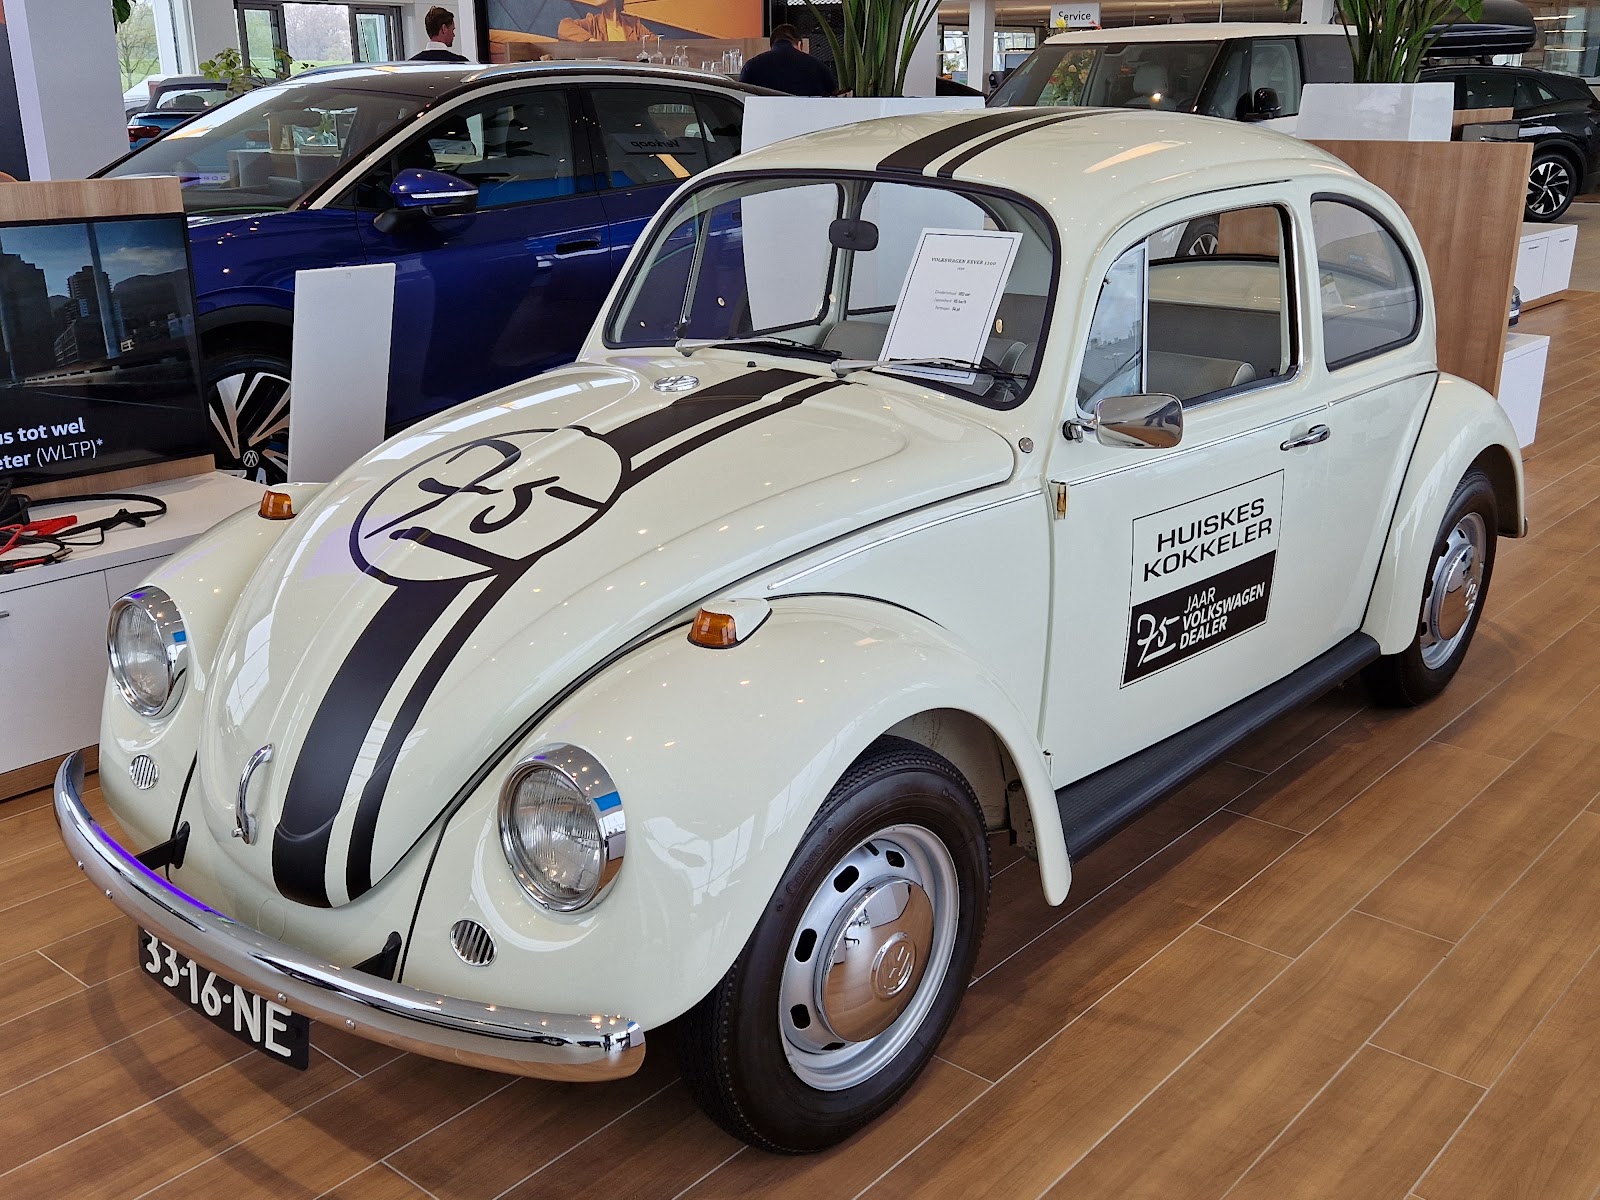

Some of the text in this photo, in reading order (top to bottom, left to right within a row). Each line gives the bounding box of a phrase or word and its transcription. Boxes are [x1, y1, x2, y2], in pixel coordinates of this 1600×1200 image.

[1058, 10, 1092, 21] Service
[17, 425, 48, 441] tot
[51, 417, 86, 436] wel
[1157, 498, 1265, 552] HUISKES
[1143, 518, 1273, 582] KOKKELER
[1182, 581, 1266, 631] VOLKSWAGEN
[1184, 586, 1217, 614] JAAR
[1179, 615, 1228, 650] DEALER
